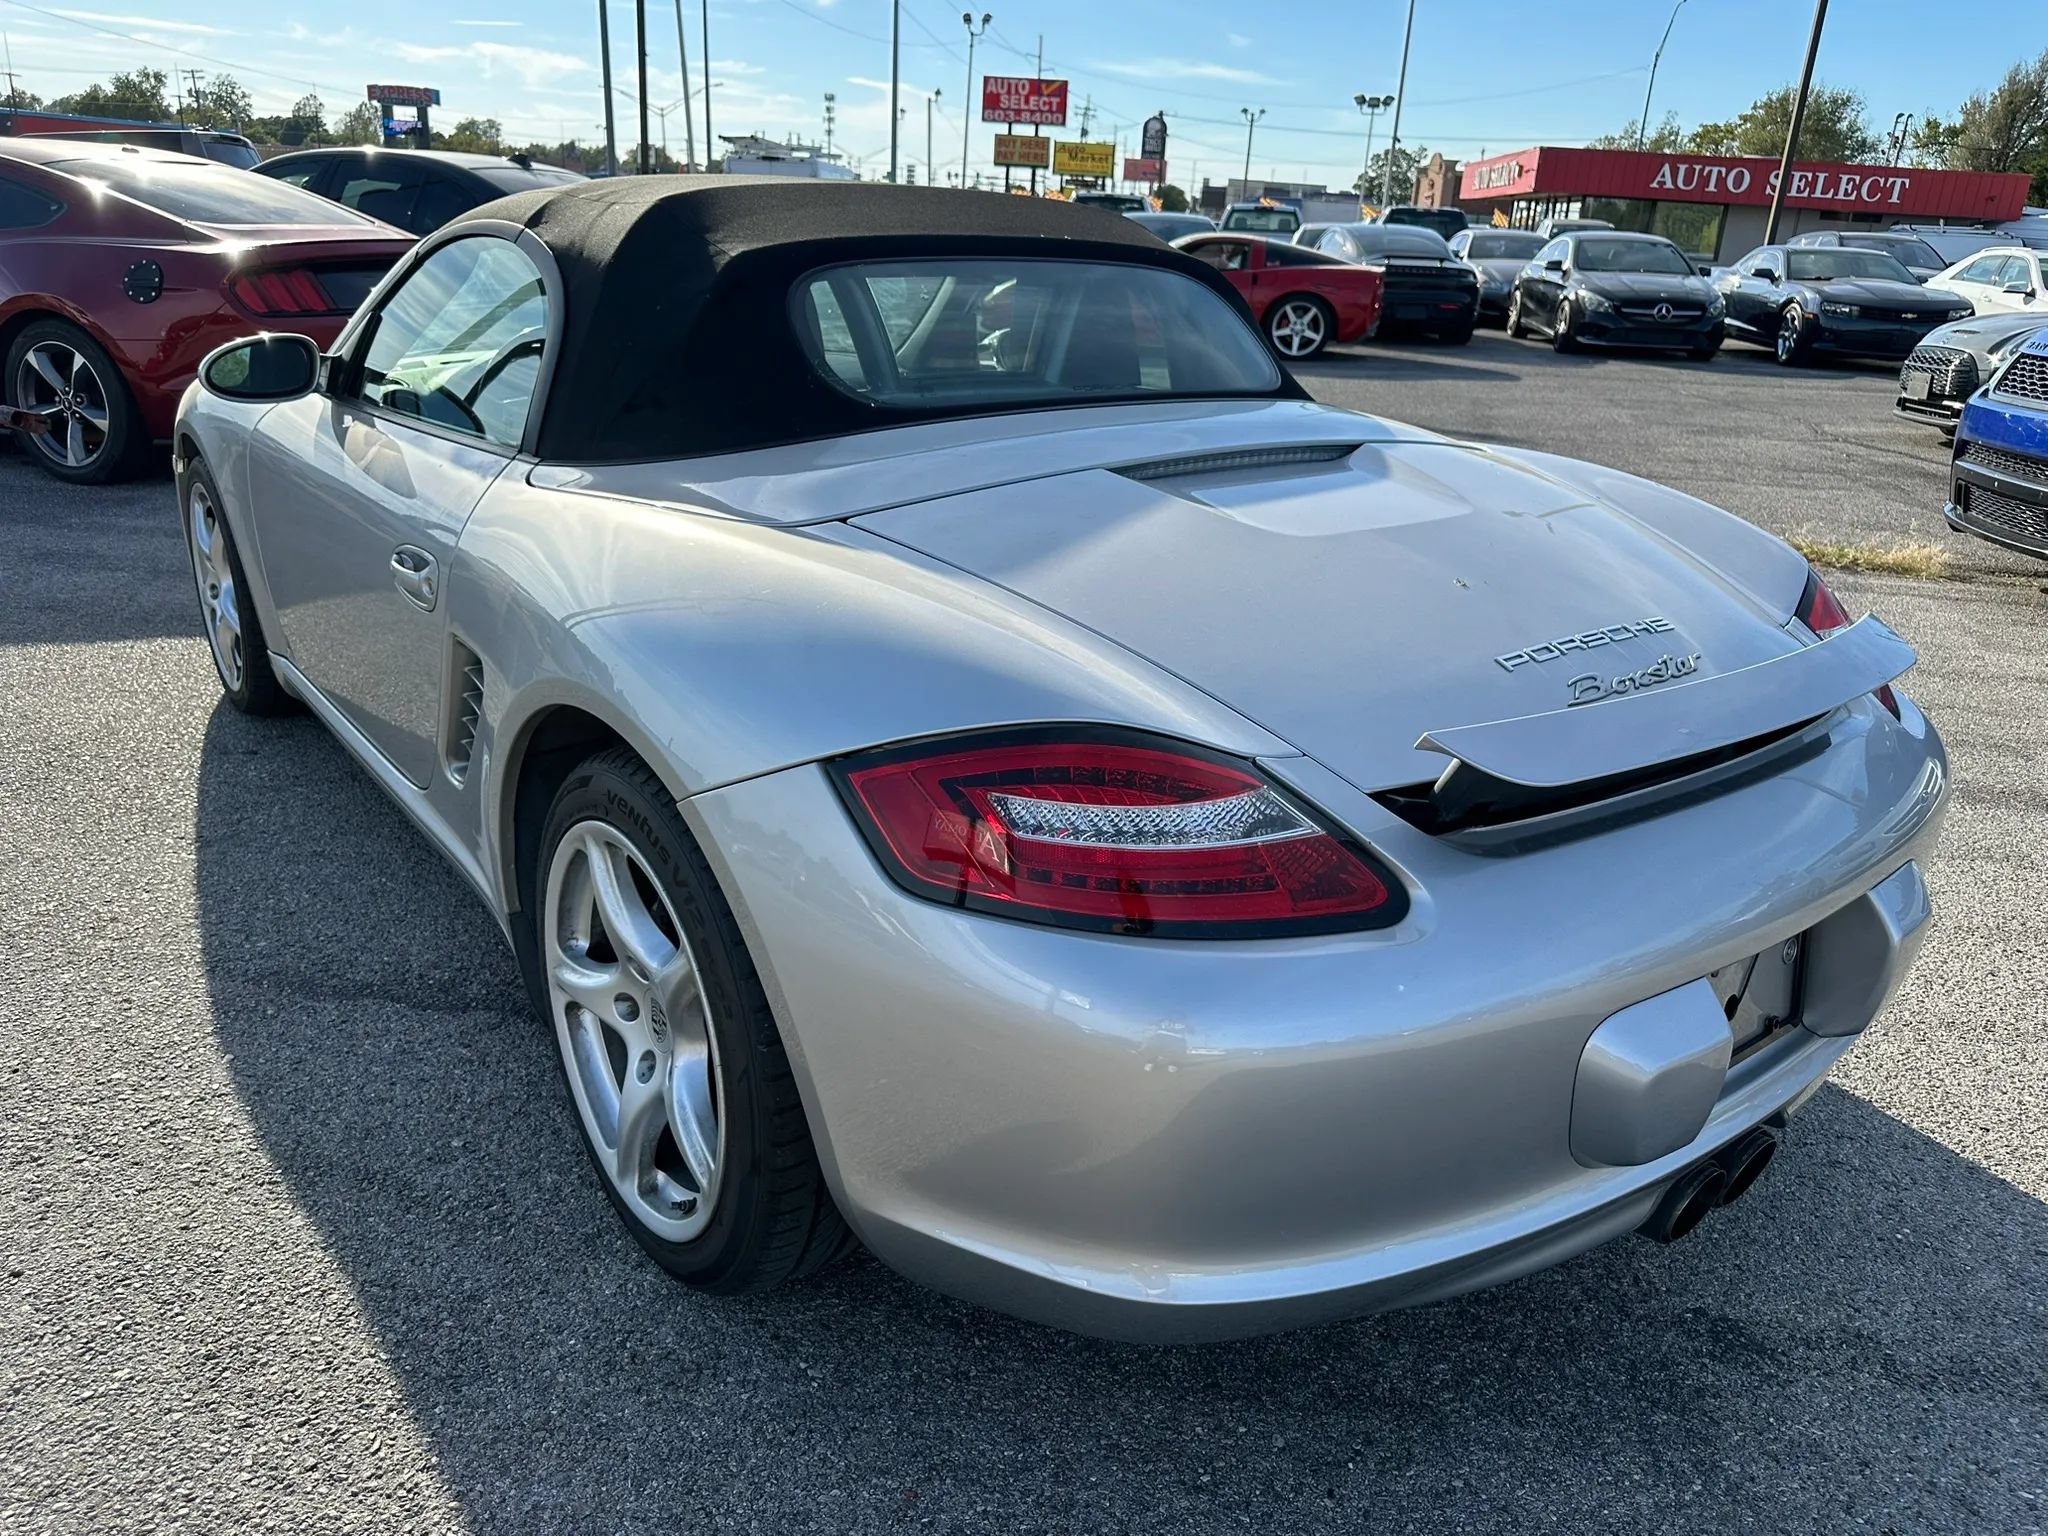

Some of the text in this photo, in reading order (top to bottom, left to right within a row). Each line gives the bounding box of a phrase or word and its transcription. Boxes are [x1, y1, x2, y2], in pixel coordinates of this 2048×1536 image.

[367, 86, 432, 105] EXPRESS
[986, 78, 1030, 95] AUTO
[1000, 95, 1060, 111] SELECT
[984, 111, 1063, 123] 603-8400
[1068, 153, 1109, 164] Market
[1649, 162, 1909, 204] AUTO SELECT
[1494, 616, 1676, 673] PORSCHE
[1567, 652, 1702, 707] Boxster
